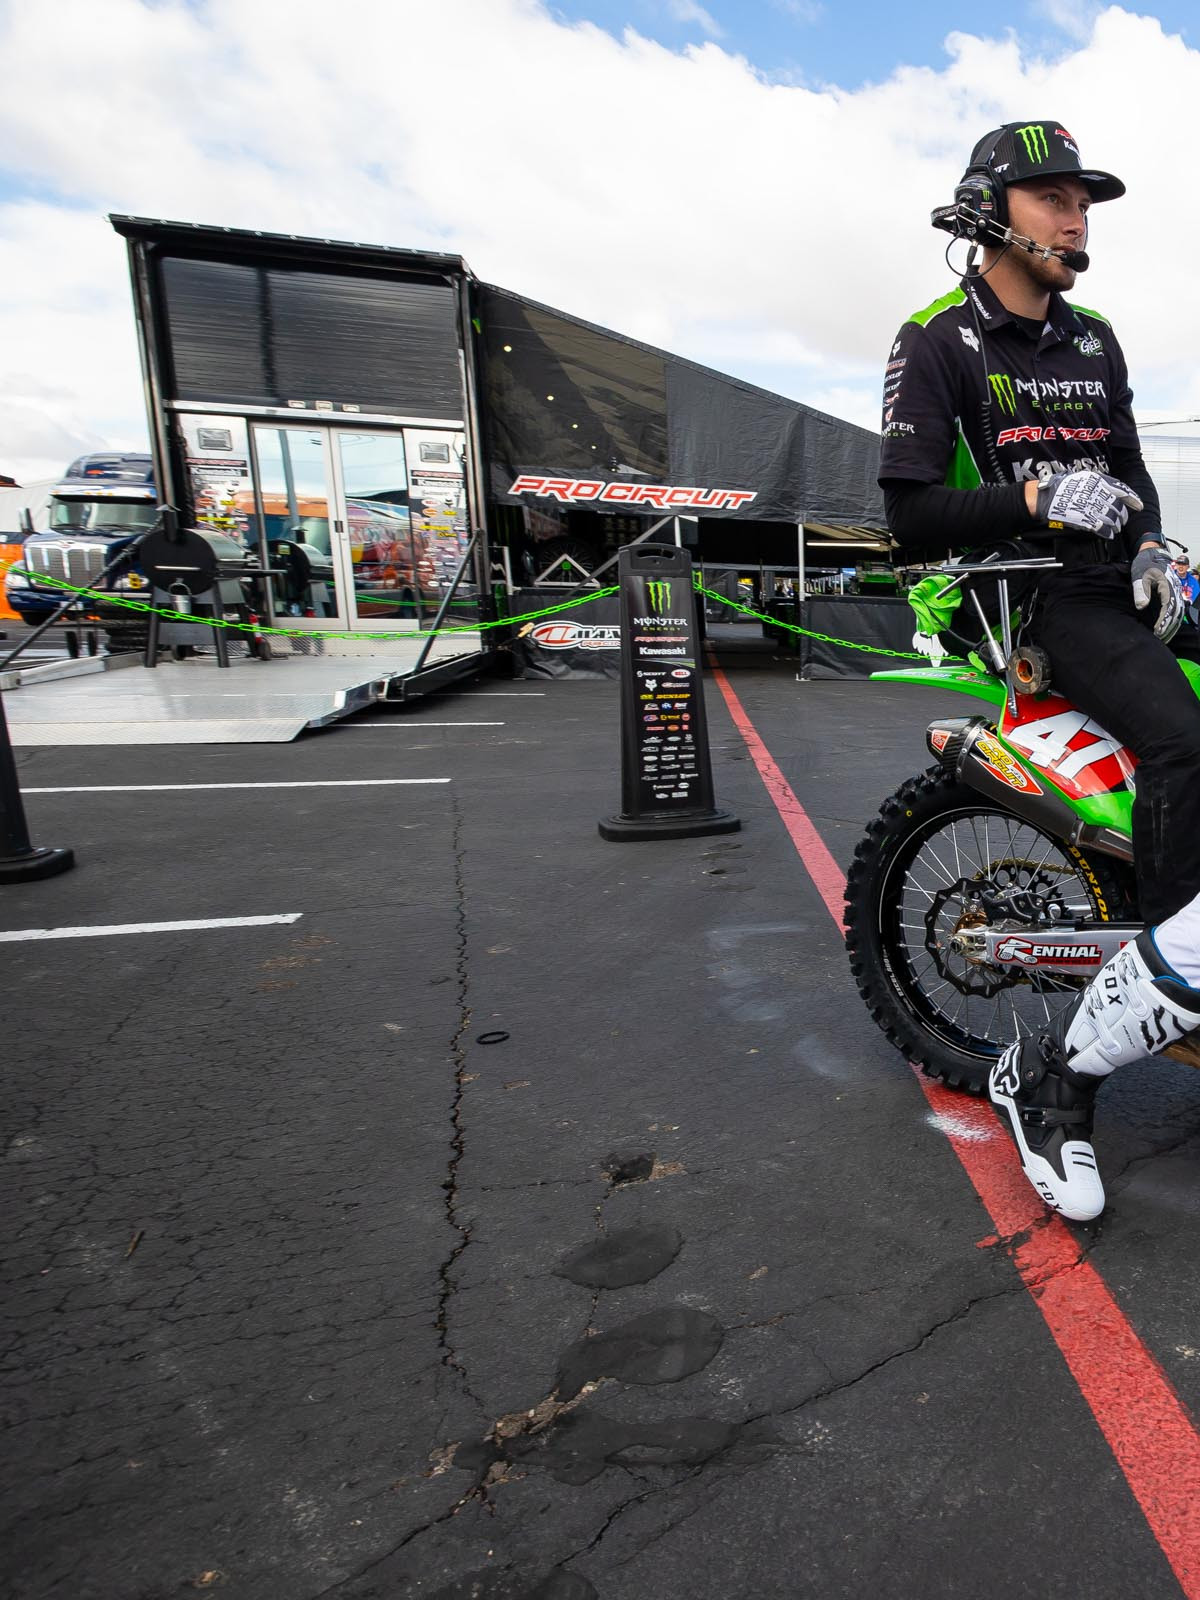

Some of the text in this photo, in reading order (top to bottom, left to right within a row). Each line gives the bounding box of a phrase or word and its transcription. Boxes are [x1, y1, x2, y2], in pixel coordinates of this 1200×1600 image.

[1014, 378, 1107, 401] MONSTER
[507, 475, 758, 509] PRO CIRCUIT
[1051, 478, 1080, 517] Mechanix
[1070, 474, 1101, 514] Mechanix
[633, 616, 688, 626] MONSTER
[639, 646, 686, 655] Kawasaki
[977, 741, 1025, 787] CIRCUIT
[1006, 709, 1124, 780] 47
[1104, 962, 1123, 1005] FOX
